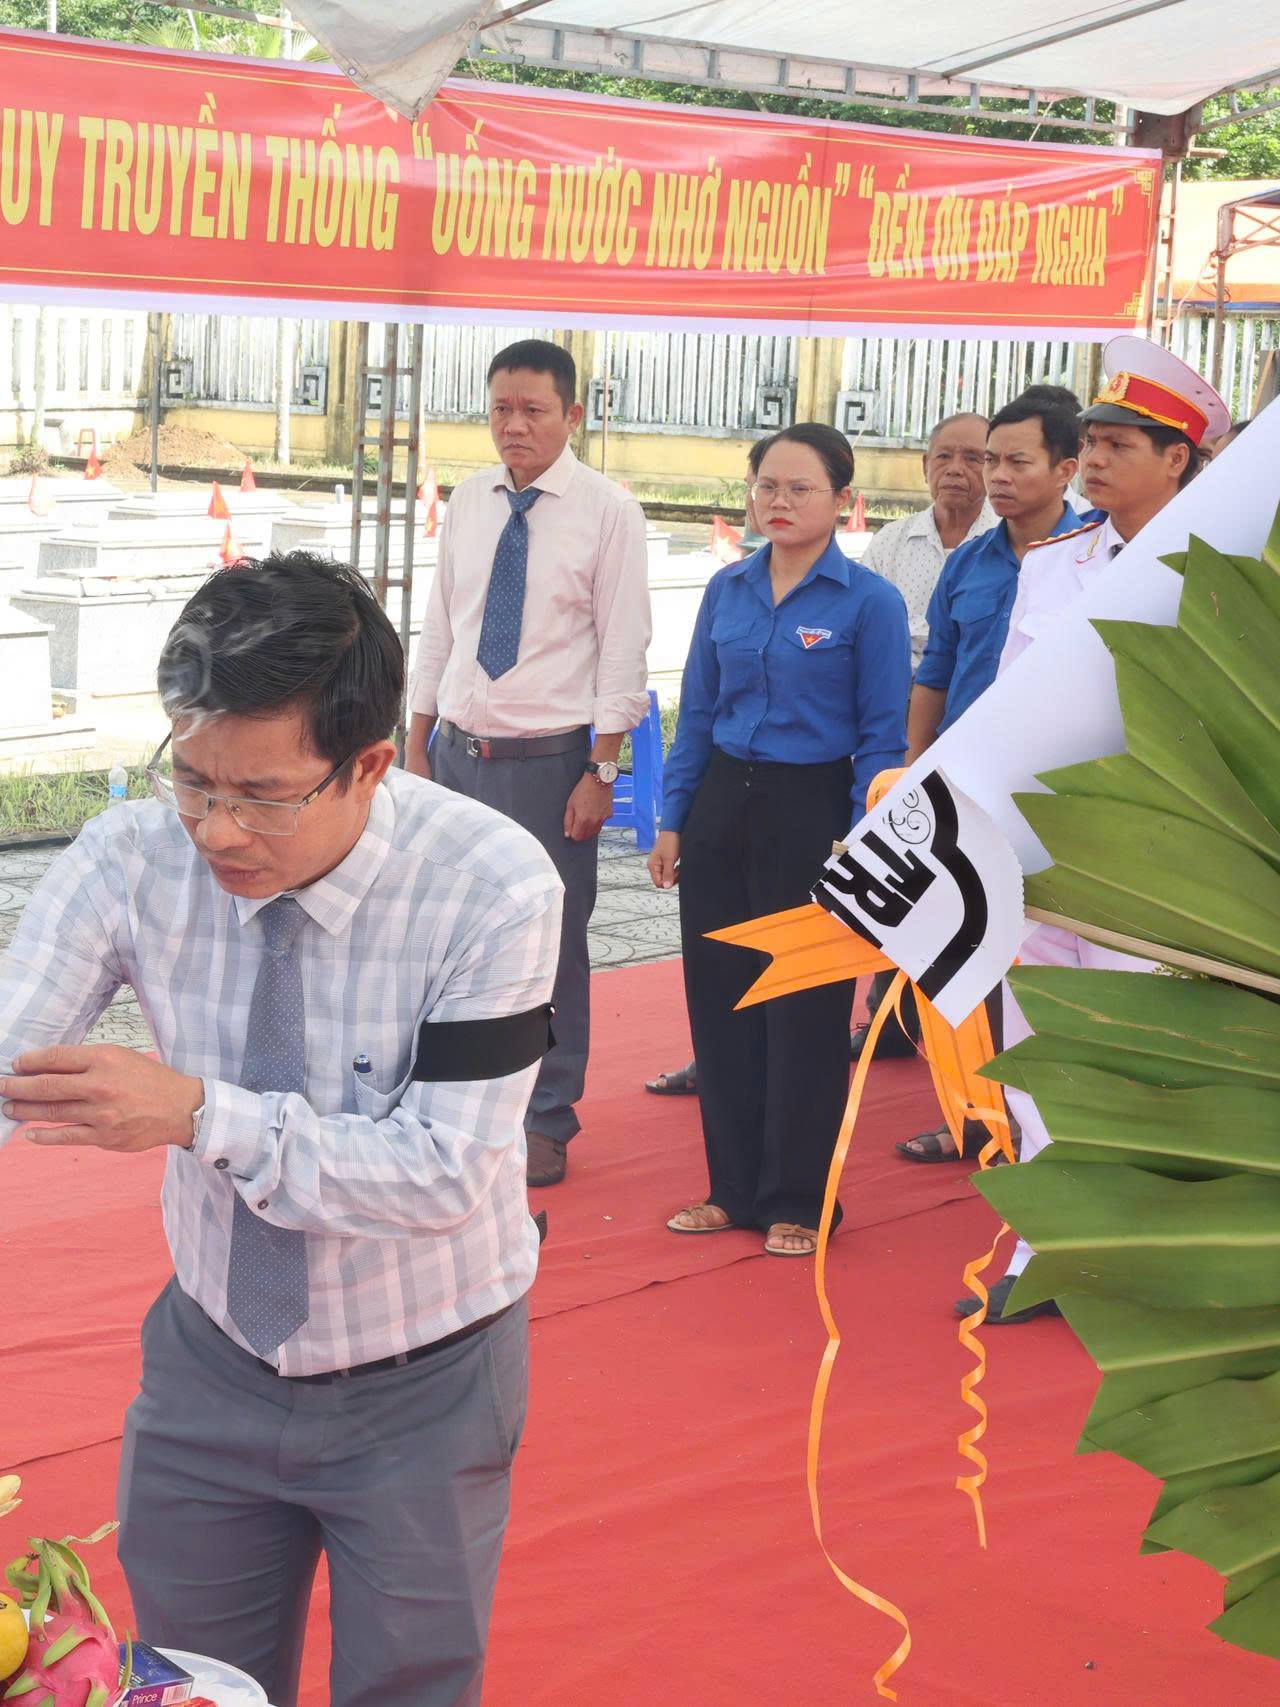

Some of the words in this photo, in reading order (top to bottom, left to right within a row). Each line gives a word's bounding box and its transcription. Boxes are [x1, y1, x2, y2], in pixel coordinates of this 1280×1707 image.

[79, 93, 251, 239] TRUYỀN
[266, 104, 400, 250] THỐNG
[542, 146, 642, 266] NƯỚC
[645, 156, 721, 270] NHỚ
[932, 187, 973, 280] ƠN
[976, 184, 1029, 283] ĐÁP
[132, 1693, 158, 1705] Prince
